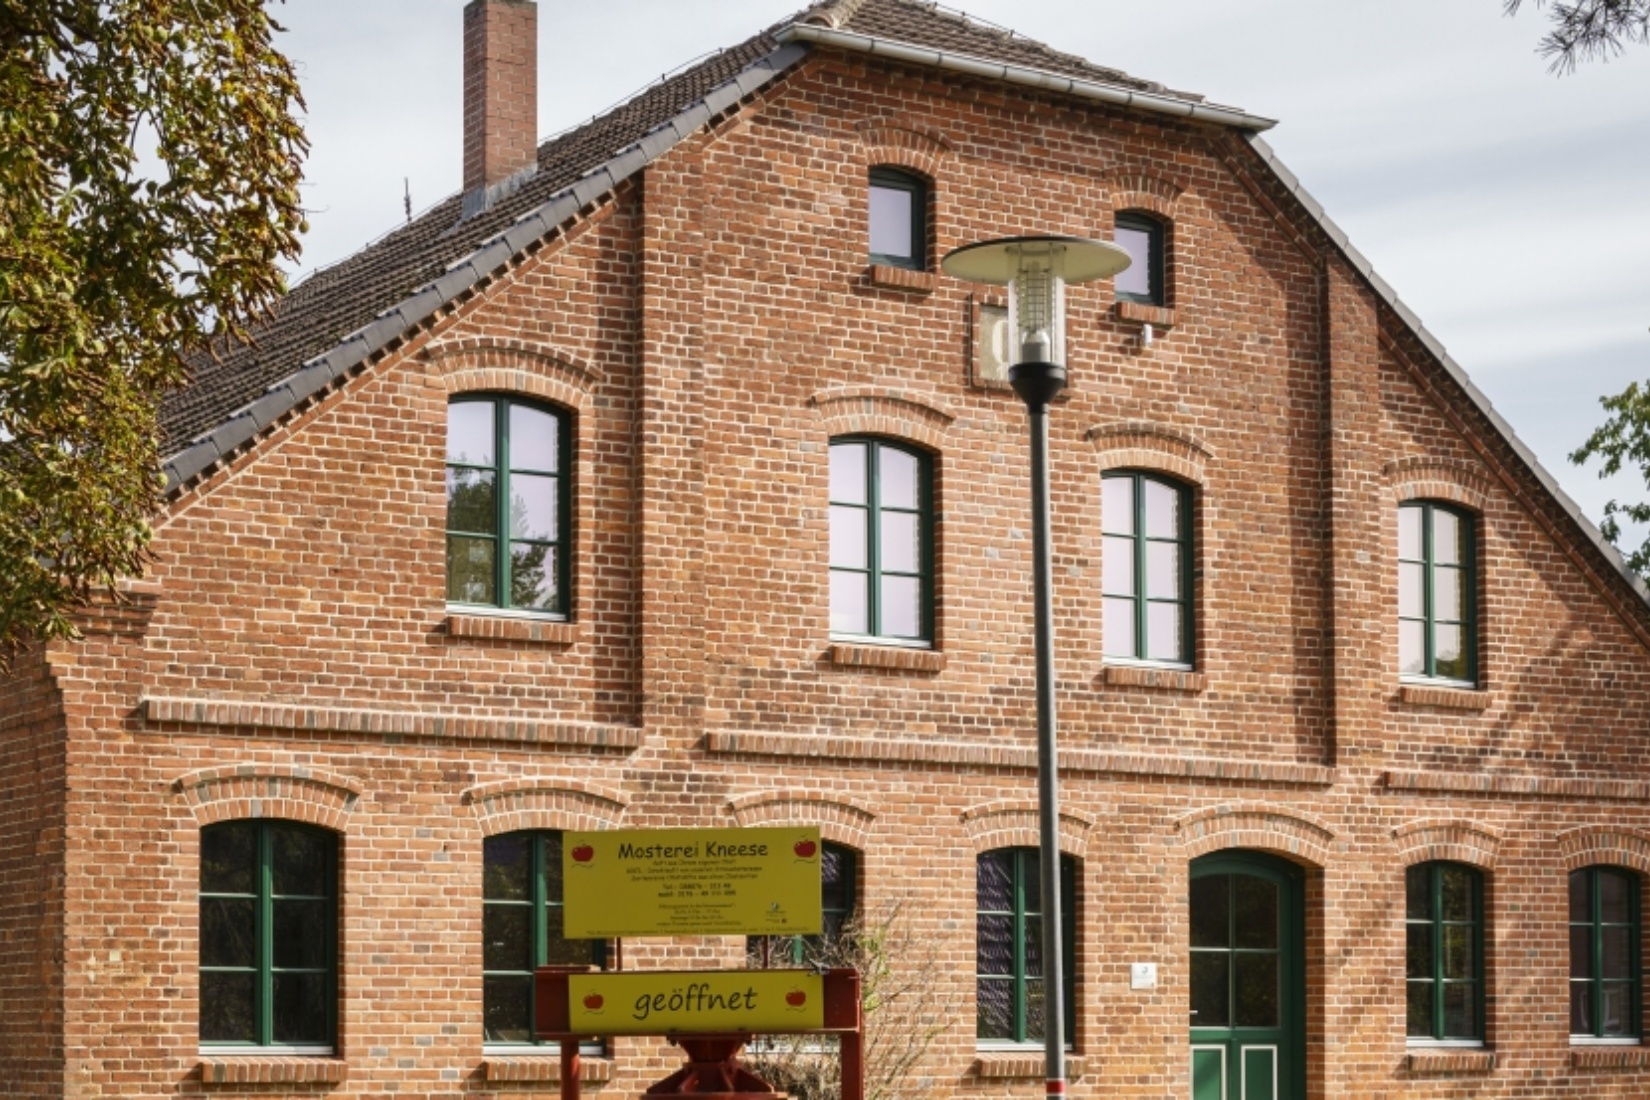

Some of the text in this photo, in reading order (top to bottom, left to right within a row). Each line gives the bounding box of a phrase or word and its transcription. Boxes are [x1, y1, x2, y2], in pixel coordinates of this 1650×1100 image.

[618, 841, 769, 860] Mosterei Kneese
[632, 983, 758, 1021] geöffnet
